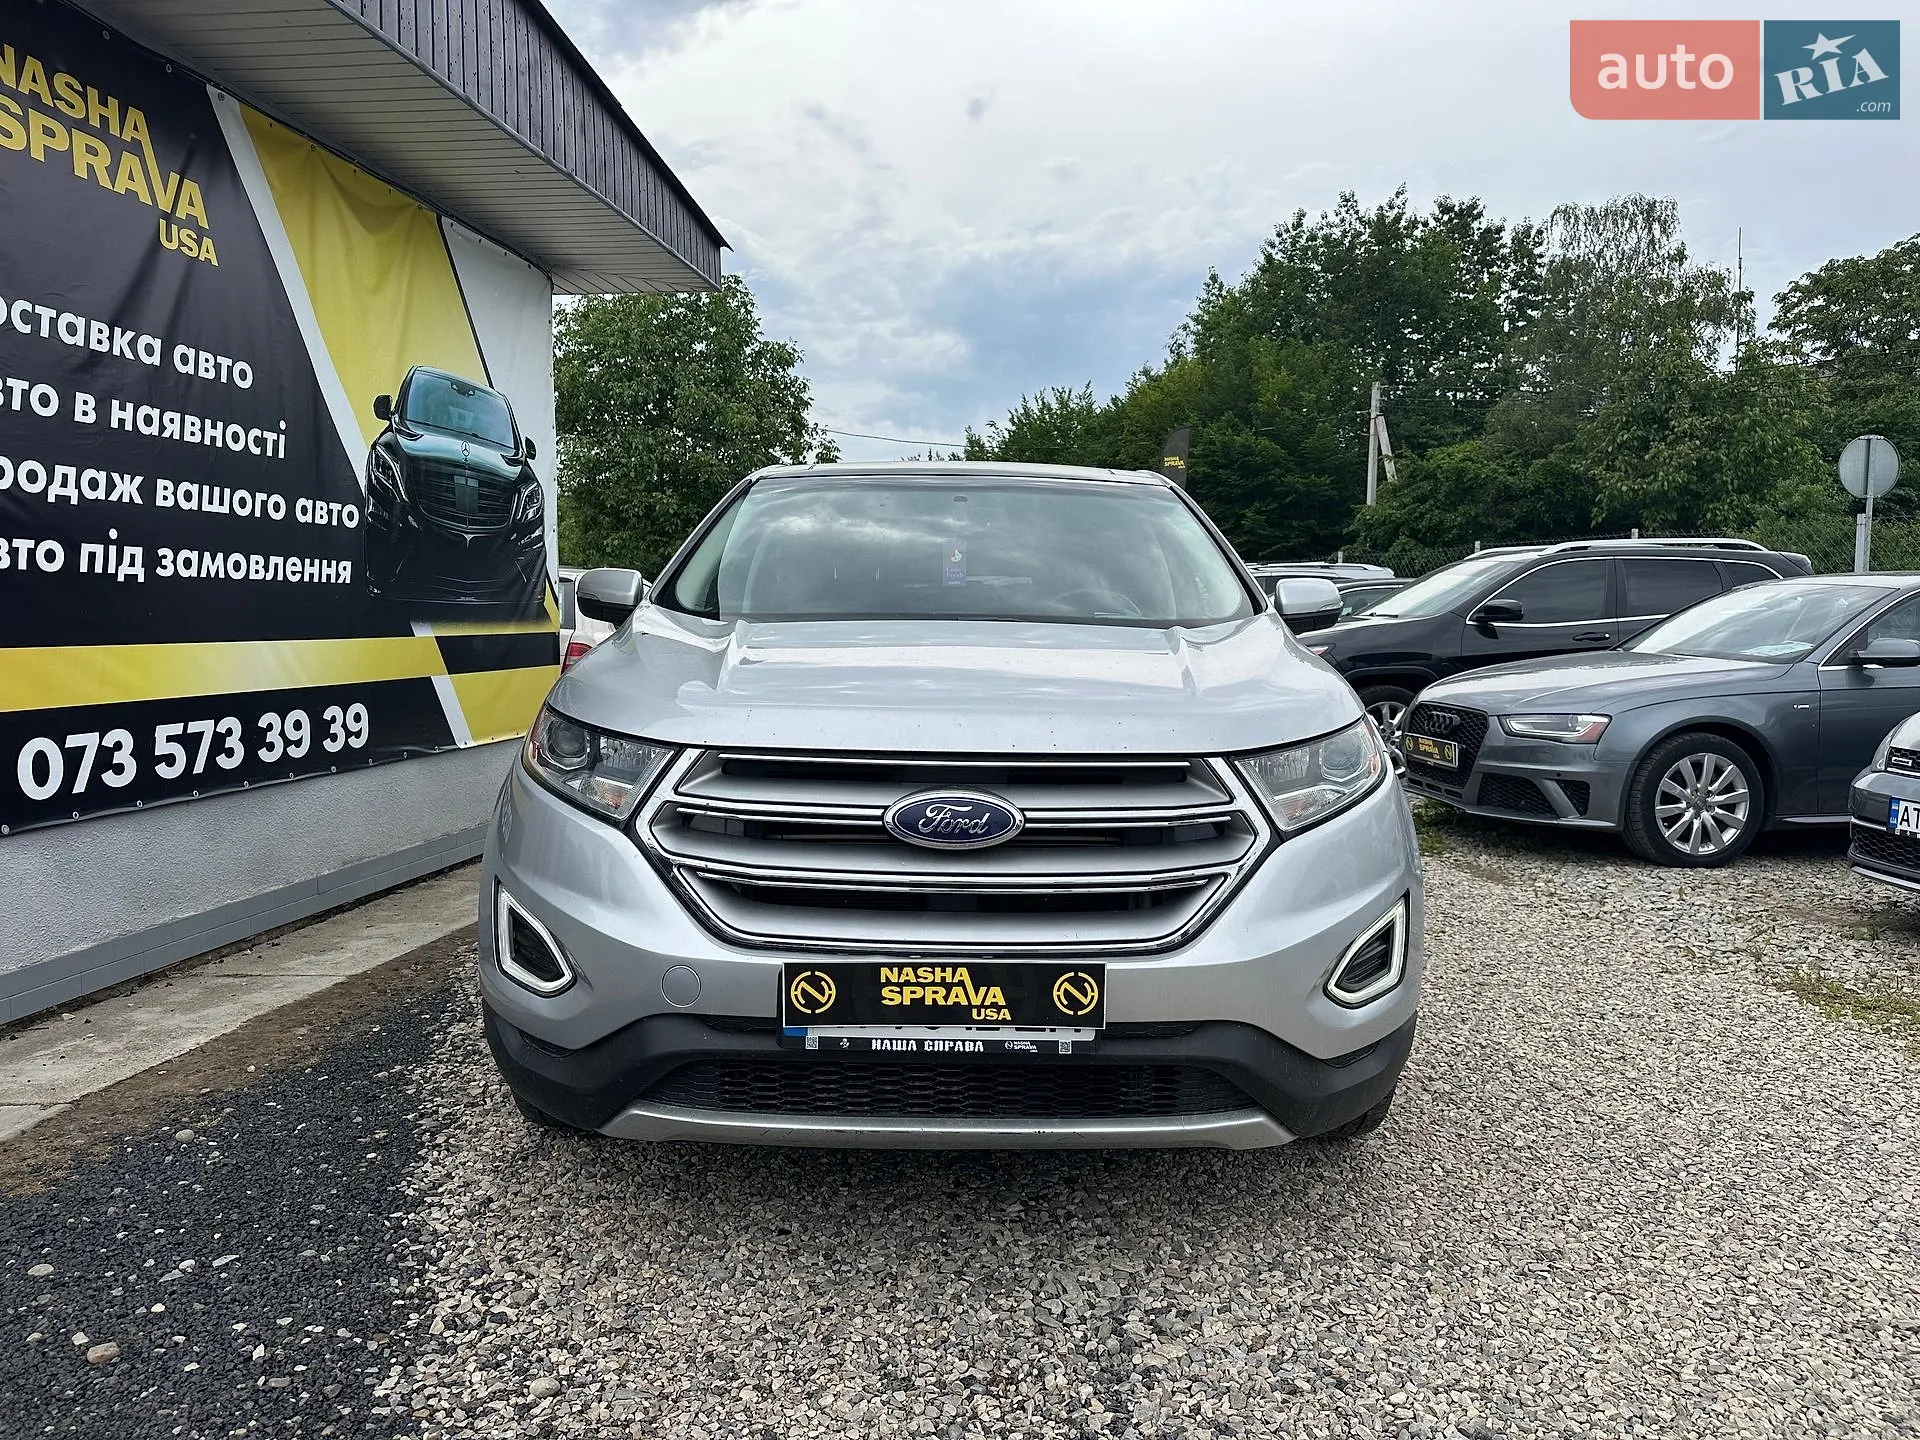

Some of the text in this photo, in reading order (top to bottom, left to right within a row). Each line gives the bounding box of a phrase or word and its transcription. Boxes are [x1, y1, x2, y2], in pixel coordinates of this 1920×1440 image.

[0, 93, 208, 229] SPRAVA
[159, 219, 219, 266] USA
[0, 295, 254, 389] ставка авто
[0, 376, 286, 459] то в наявності
[155, 478, 287, 521] вашого
[295, 497, 360, 529] авто
[79, 528, 145, 583] під
[155, 547, 352, 584] замовлення
[17, 702, 369, 801] 073 573 39 39
[918, 803, 991, 834] Ford
[880, 967, 968, 983] NASHA
[881, 986, 1006, 1006] SPRAVA
[971, 1008, 1012, 1021] USA
[871, 1039, 984, 1053] НАША СПРАВА
